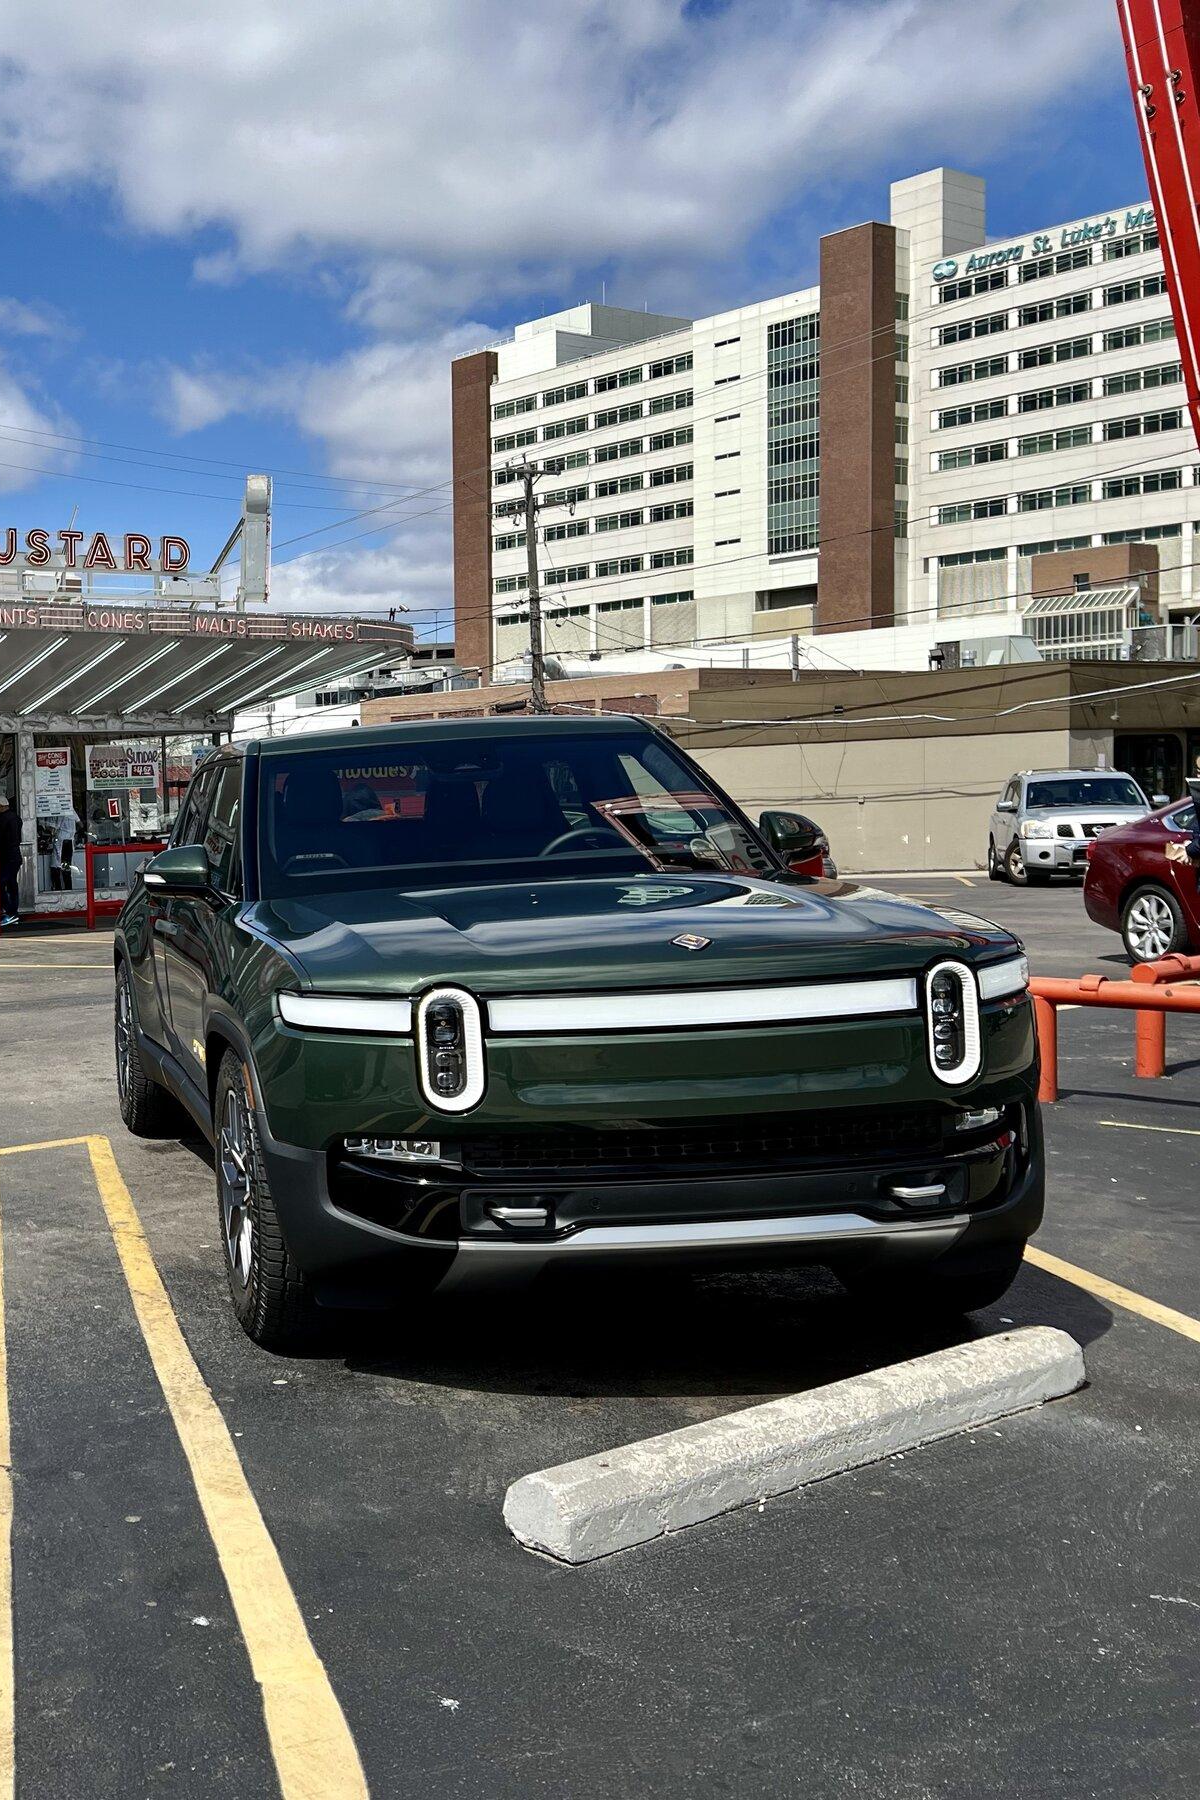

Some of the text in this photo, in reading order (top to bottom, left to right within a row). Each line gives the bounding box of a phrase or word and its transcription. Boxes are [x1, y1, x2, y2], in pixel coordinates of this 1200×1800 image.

[965, 244, 1024, 275] Aurora
[1061, 216, 1117, 250] Luke's
[88, 612, 144, 630] CONES
[196, 617, 247, 635] MALTS
[291, 622, 354, 639] SHAKES
